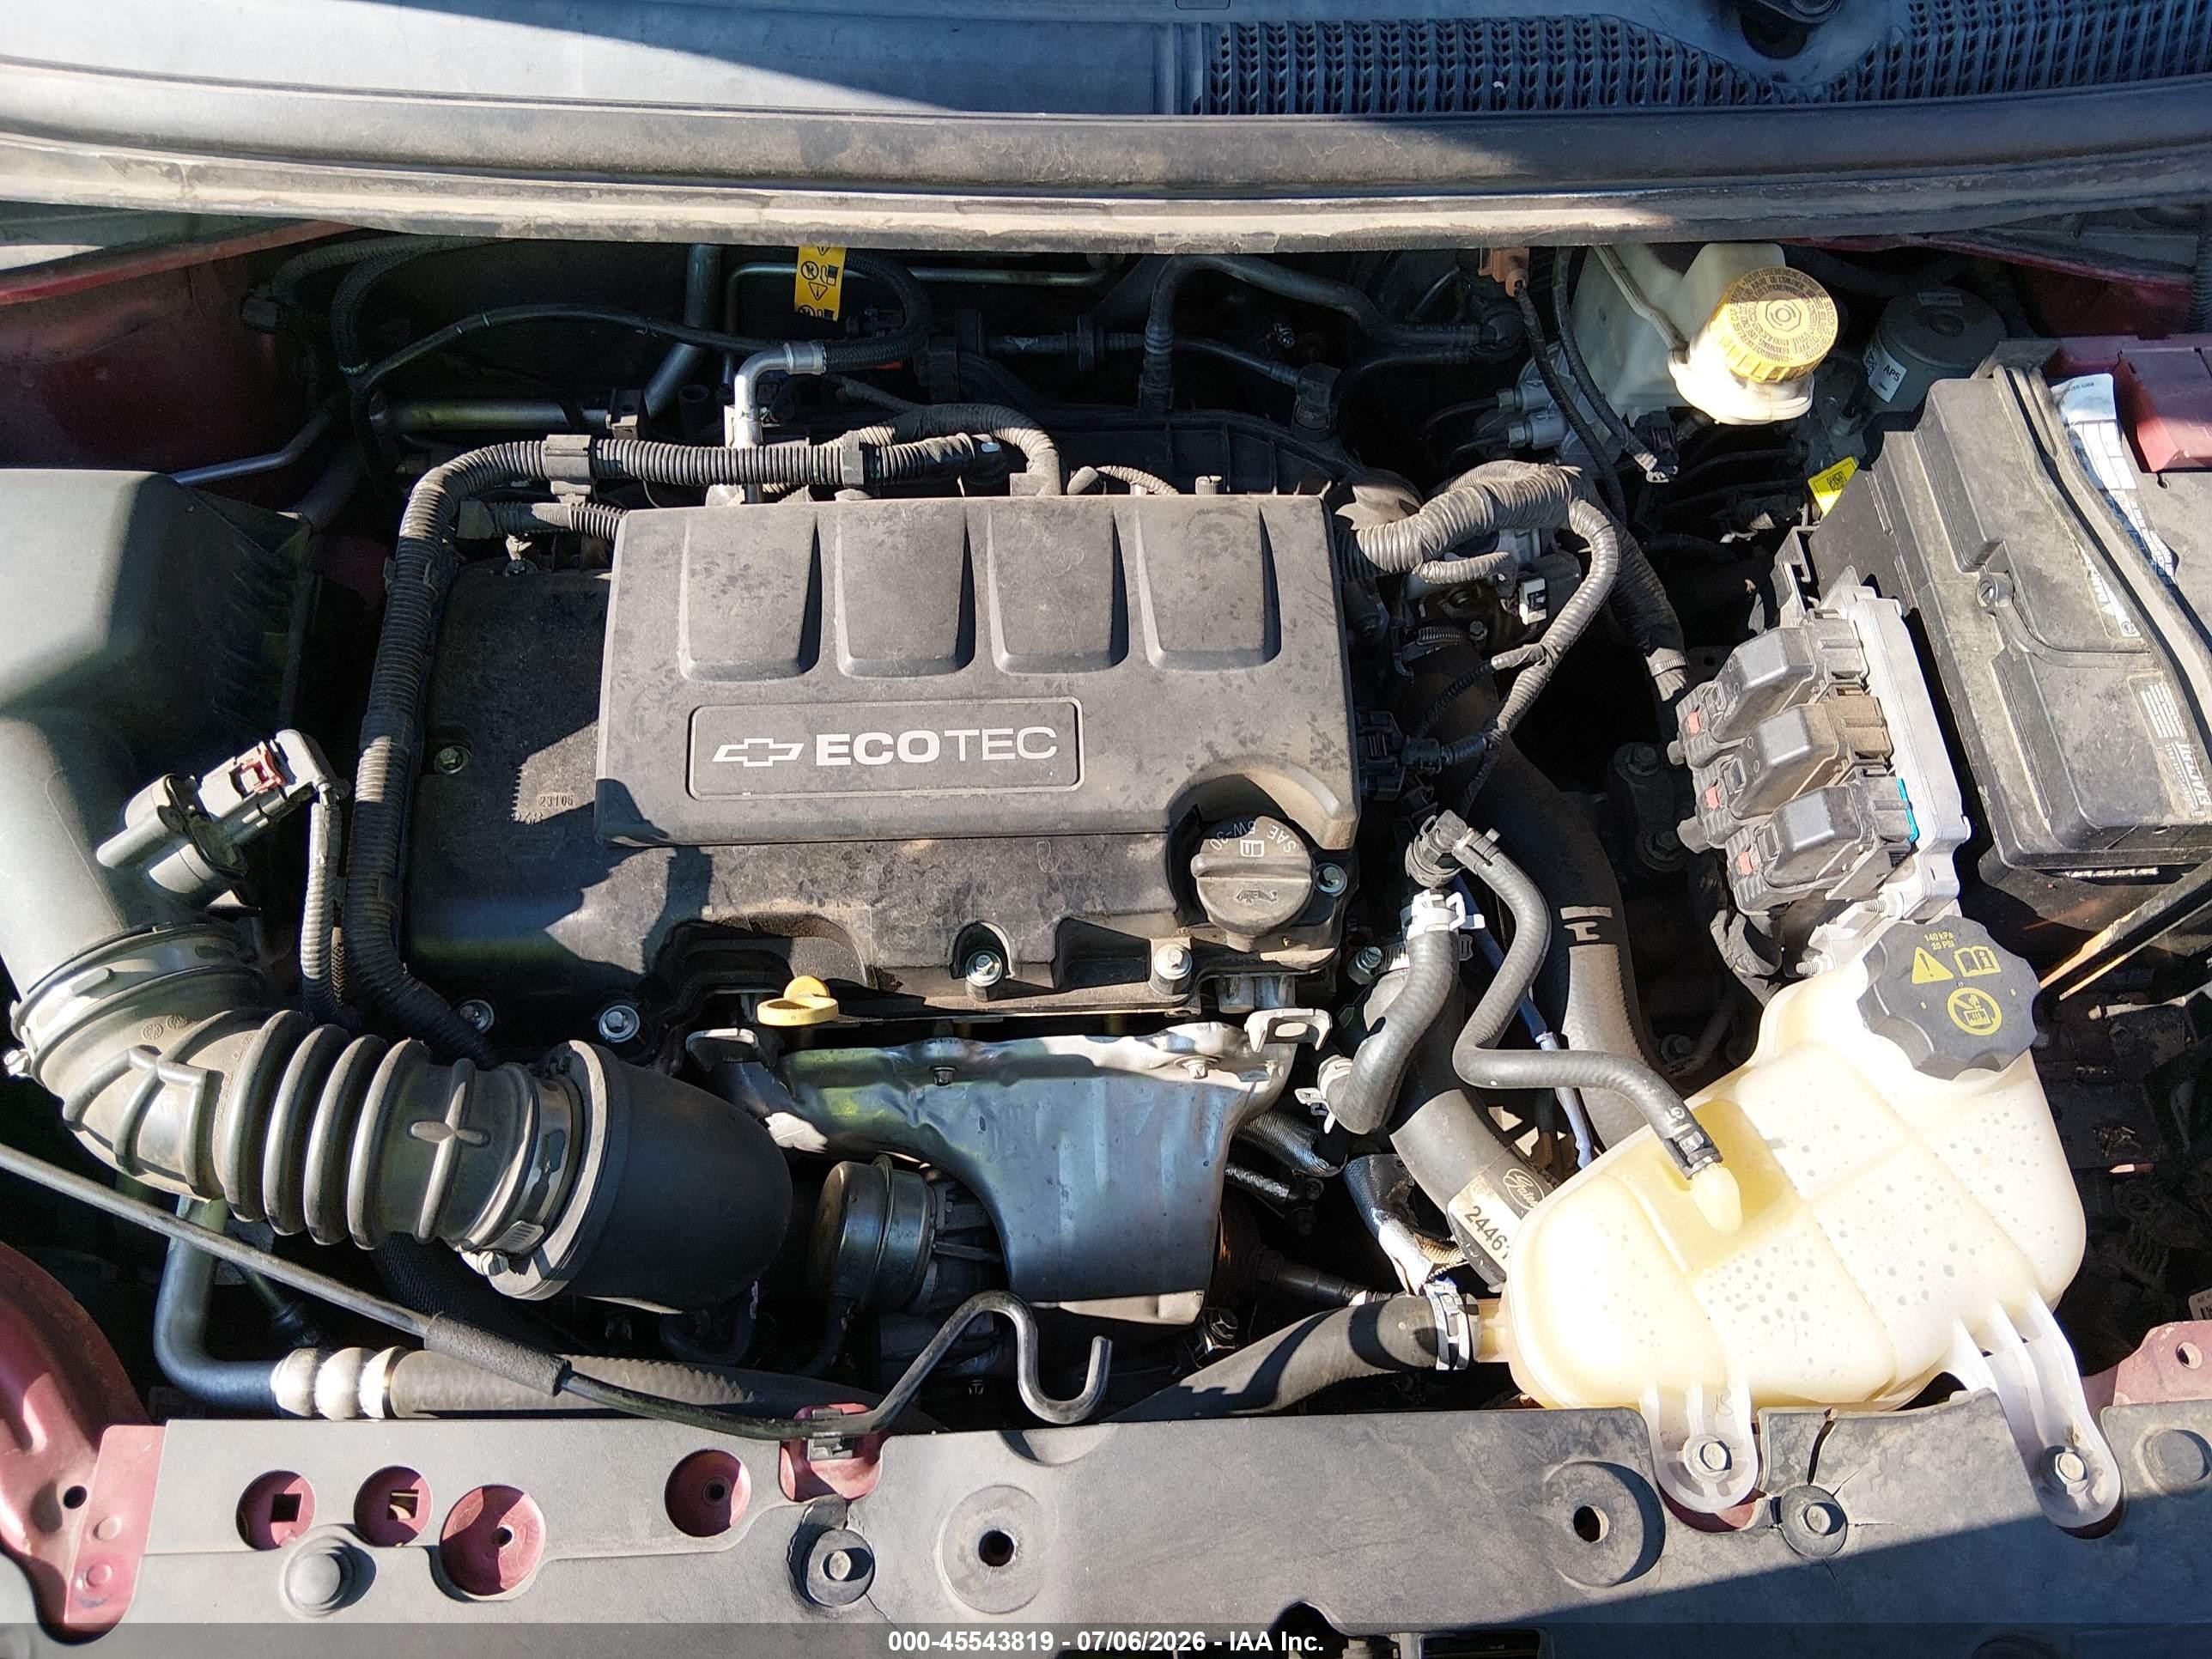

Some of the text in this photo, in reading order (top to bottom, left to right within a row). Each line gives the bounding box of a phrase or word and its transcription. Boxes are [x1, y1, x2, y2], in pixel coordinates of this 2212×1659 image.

[816, 726, 1057, 766] ECOTEC
[1209, 820, 1297, 853] SAE 5W-30
[1924, 931, 1954, 942] 140 kPa
[1931, 939, 1955, 951] 20 PSI
